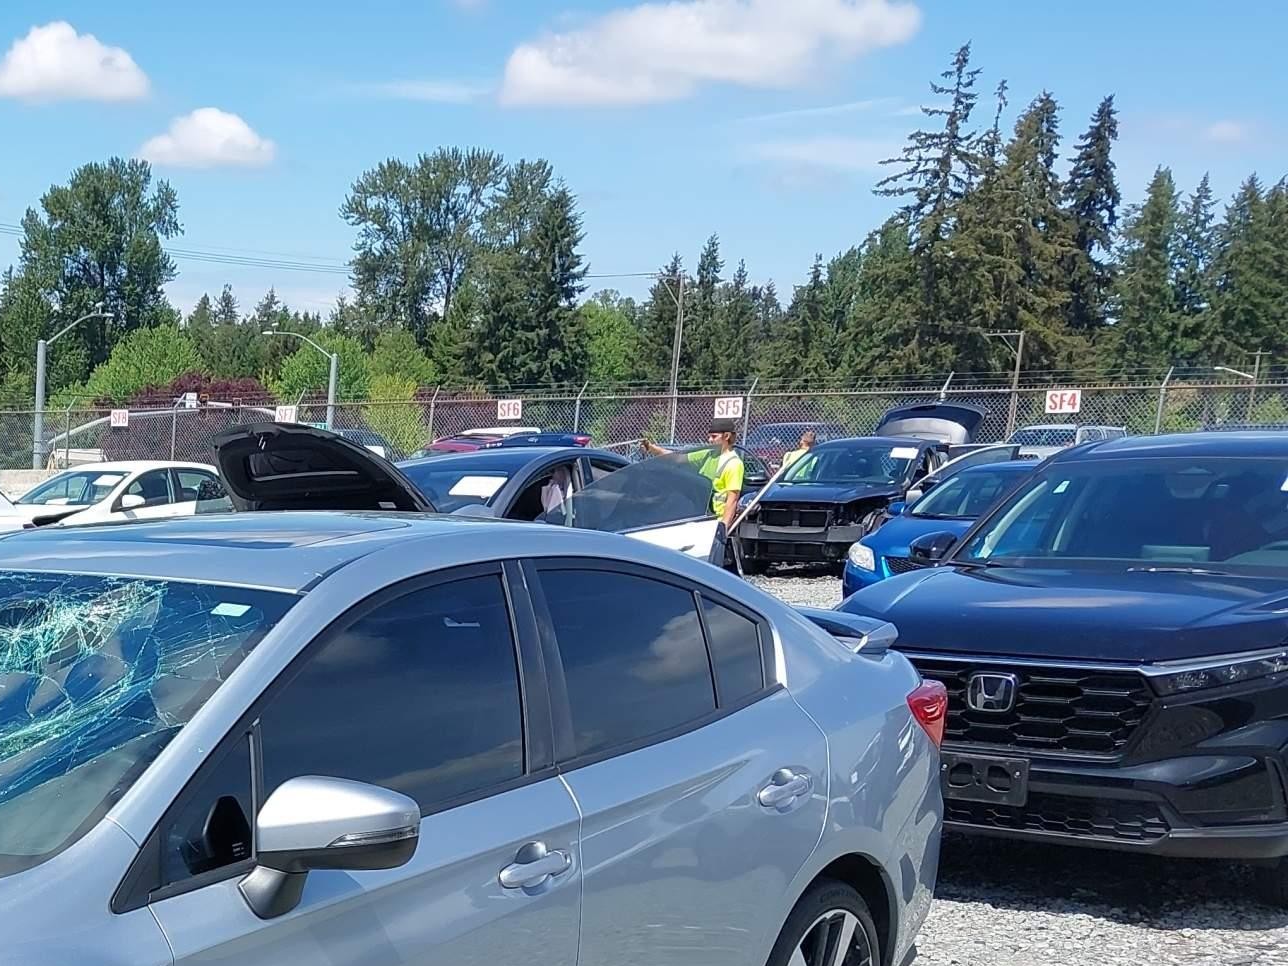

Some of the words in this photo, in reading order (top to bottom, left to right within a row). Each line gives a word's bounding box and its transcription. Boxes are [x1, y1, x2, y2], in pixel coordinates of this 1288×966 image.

[717, 399, 740, 415] SF5
[1049, 392, 1077, 410] SF4
[278, 408, 293, 421] SF7
[499, 402, 519, 416] SF6
[112, 411, 127, 424] SF8
